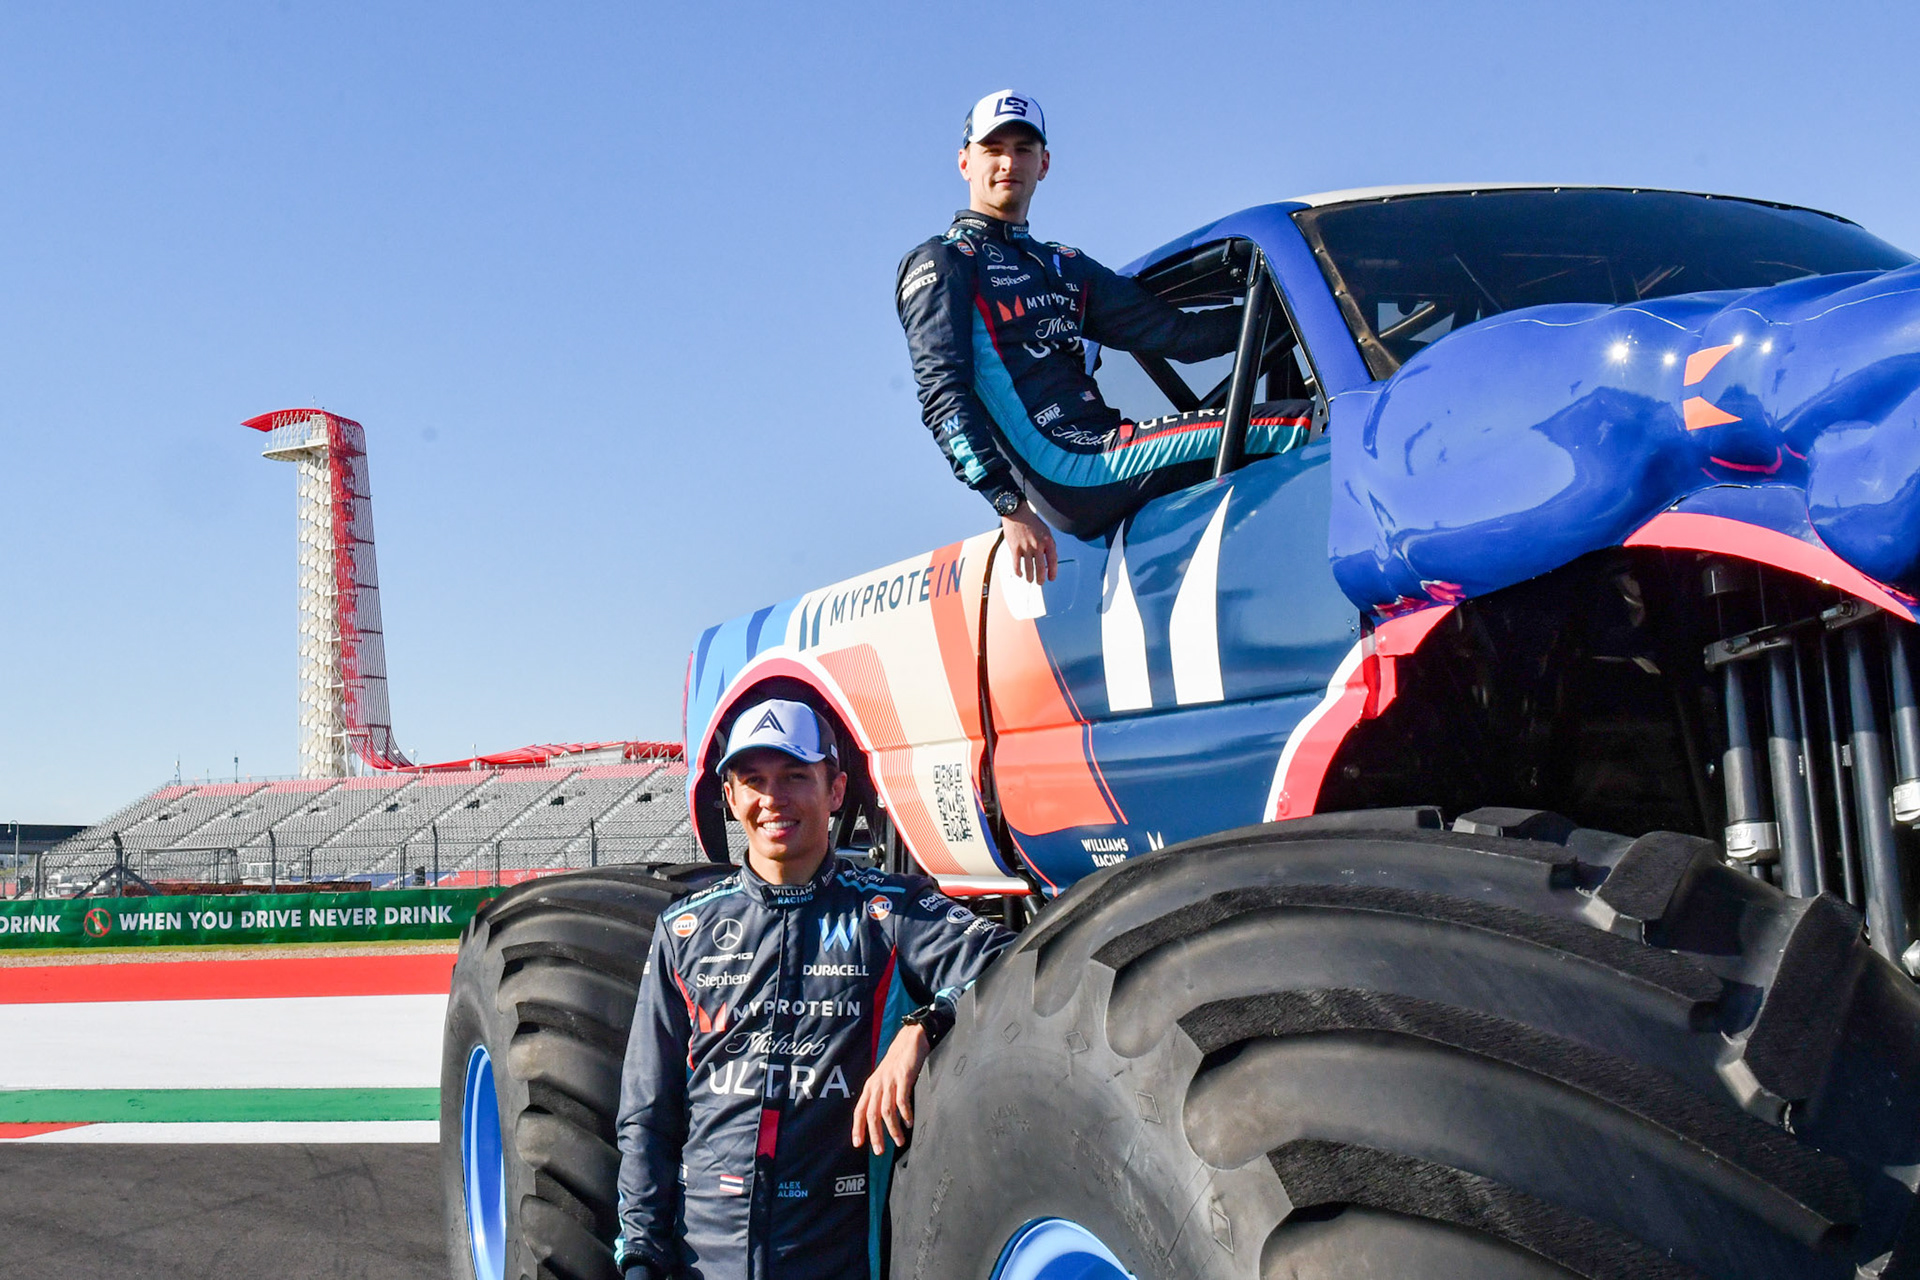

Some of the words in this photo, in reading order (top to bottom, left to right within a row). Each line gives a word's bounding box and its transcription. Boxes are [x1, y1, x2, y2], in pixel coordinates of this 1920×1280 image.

[990, 273, 1031, 288] Stephens
[1035, 404, 1063, 426] OMP
[829, 556, 966, 627] MYPROTEIN
[1081, 838, 1129, 852] WILLIAMS
[771, 883, 817, 896] WILLIAMS
[777, 895, 814, 905] RACING
[119, 912, 181, 931] WHEN
[188, 911, 233, 930] YOU
[241, 910, 301, 928] DRIVE
[309, 908, 377, 926] NEVER
[384, 906, 453, 925] DRINK
[802, 964, 869, 976] DURACELL
[696, 971, 751, 988] Stephens
[732, 998, 860, 1022] MYPROTEIN
[725, 1031, 830, 1057] Michelob
[708, 1060, 851, 1100] ULTRA
[777, 1189, 808, 1198] ALBON
[778, 1181, 800, 1189] ALEX
[834, 1176, 865, 1194] OMP
